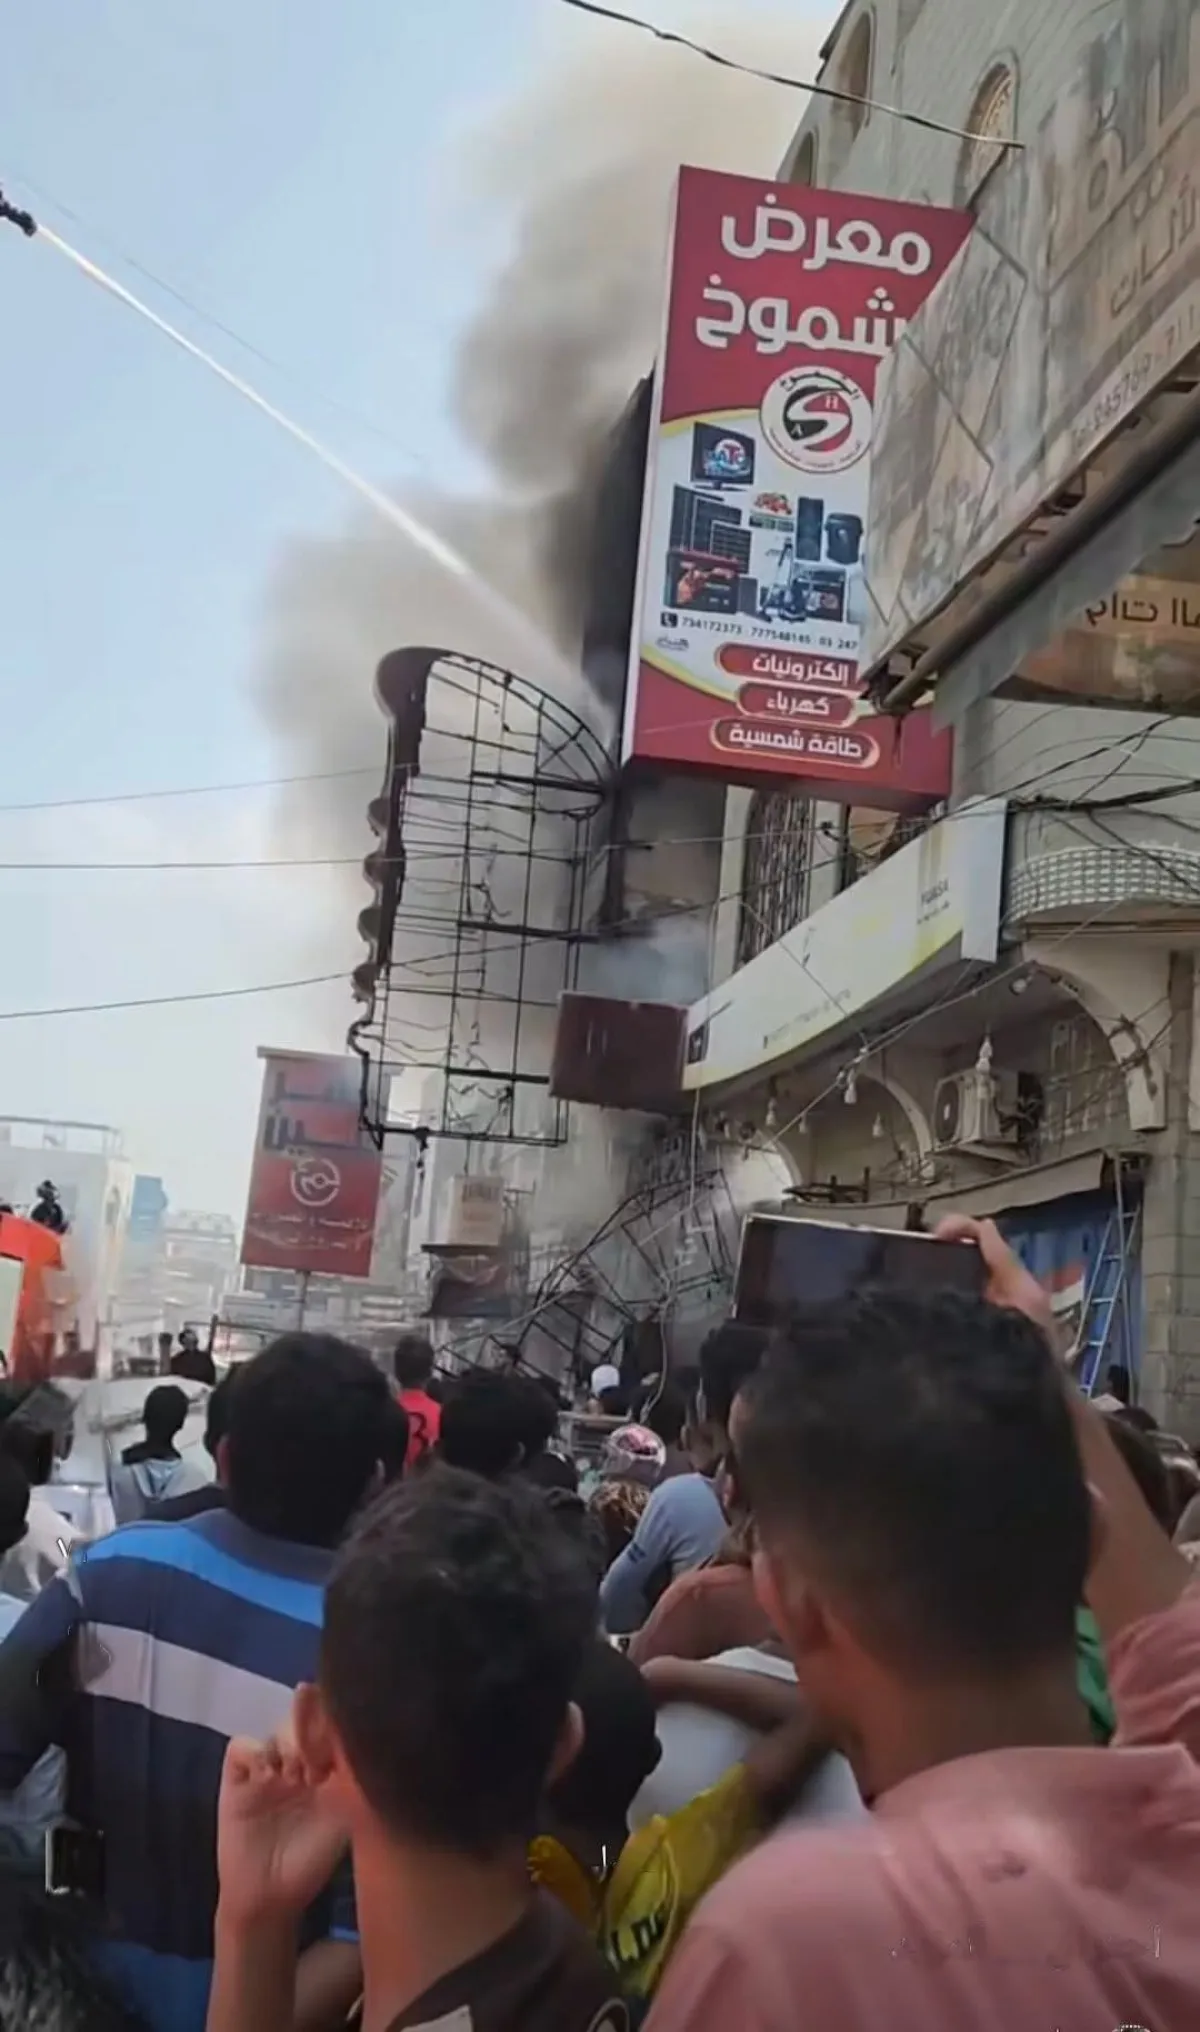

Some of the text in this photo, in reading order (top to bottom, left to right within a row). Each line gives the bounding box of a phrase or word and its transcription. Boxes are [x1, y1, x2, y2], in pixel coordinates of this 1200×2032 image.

[721, 194, 931, 275] معرض
[695, 273, 909, 357] شموخ
[753, 653, 849, 687] إلكترونيات
[766, 690, 830, 716] كهرباء
[729, 723, 862, 758] طاقة شمسية
